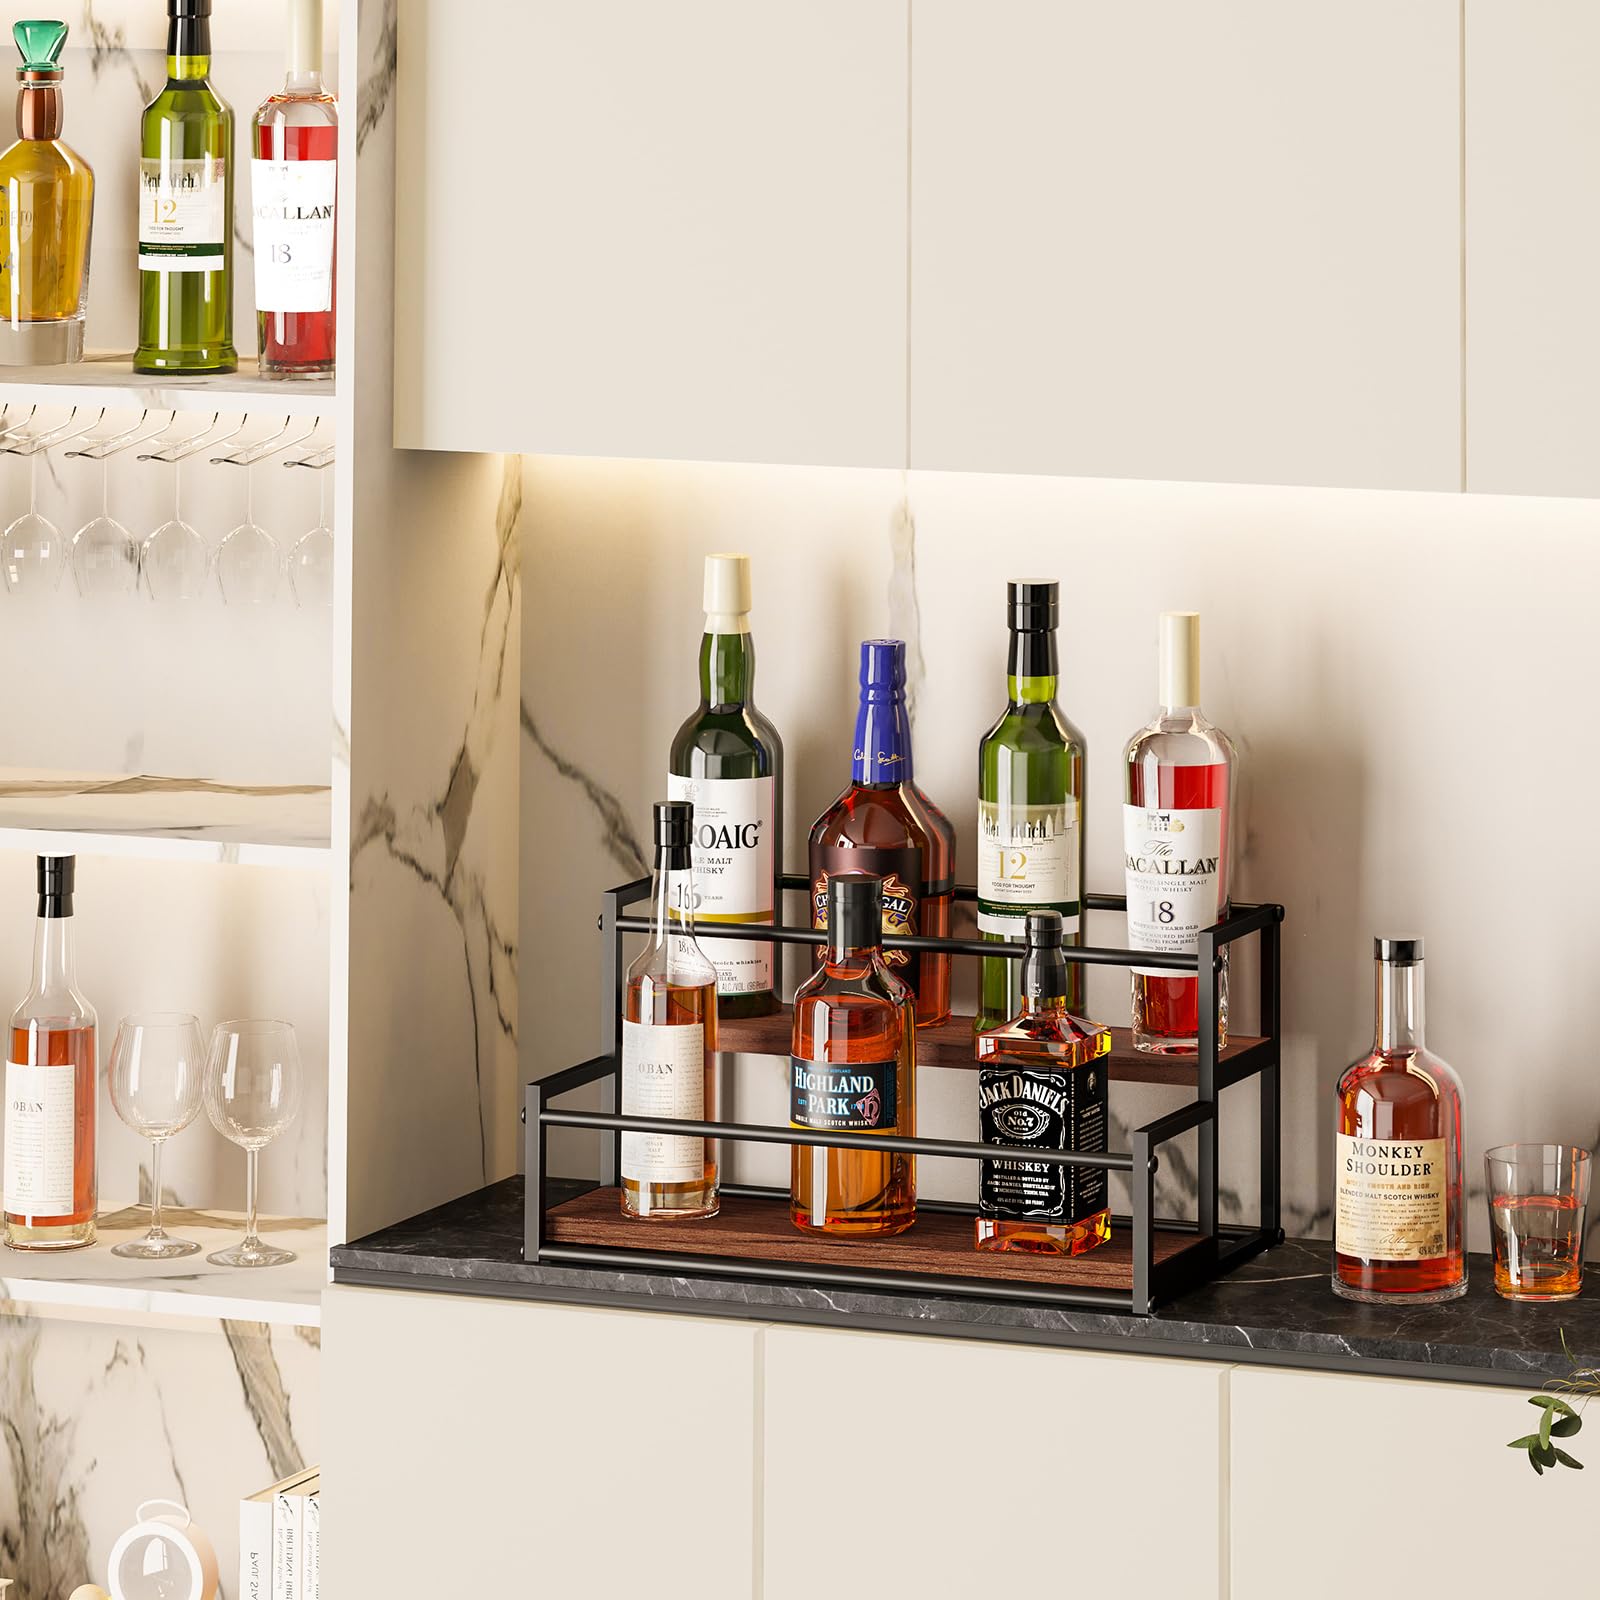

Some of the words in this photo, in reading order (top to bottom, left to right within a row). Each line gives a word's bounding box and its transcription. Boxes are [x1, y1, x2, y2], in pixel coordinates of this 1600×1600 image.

[152, 199, 177, 223] 12
[271, 243, 291, 263] 18
[1141, 839, 1174, 857] The
[707, 857, 733, 865] MALT
[996, 851, 1027, 880] 12
[1150, 900, 1175, 923] 18
[638, 1063, 673, 1074] OBAN
[794, 1065, 874, 1094] HIGHLAND
[979, 1081, 1012, 1109] JACK
[13, 1101, 44, 1112] OBAN
[808, 1093, 851, 1116] PARK
[1352, 1141, 1424, 1159] MONKEY
[992, 1159, 1050, 1173] WHISKEY
[1346, 1158, 1431, 1176] SHOULDER
[1413, 1192, 1440, 1200] WHISKY
